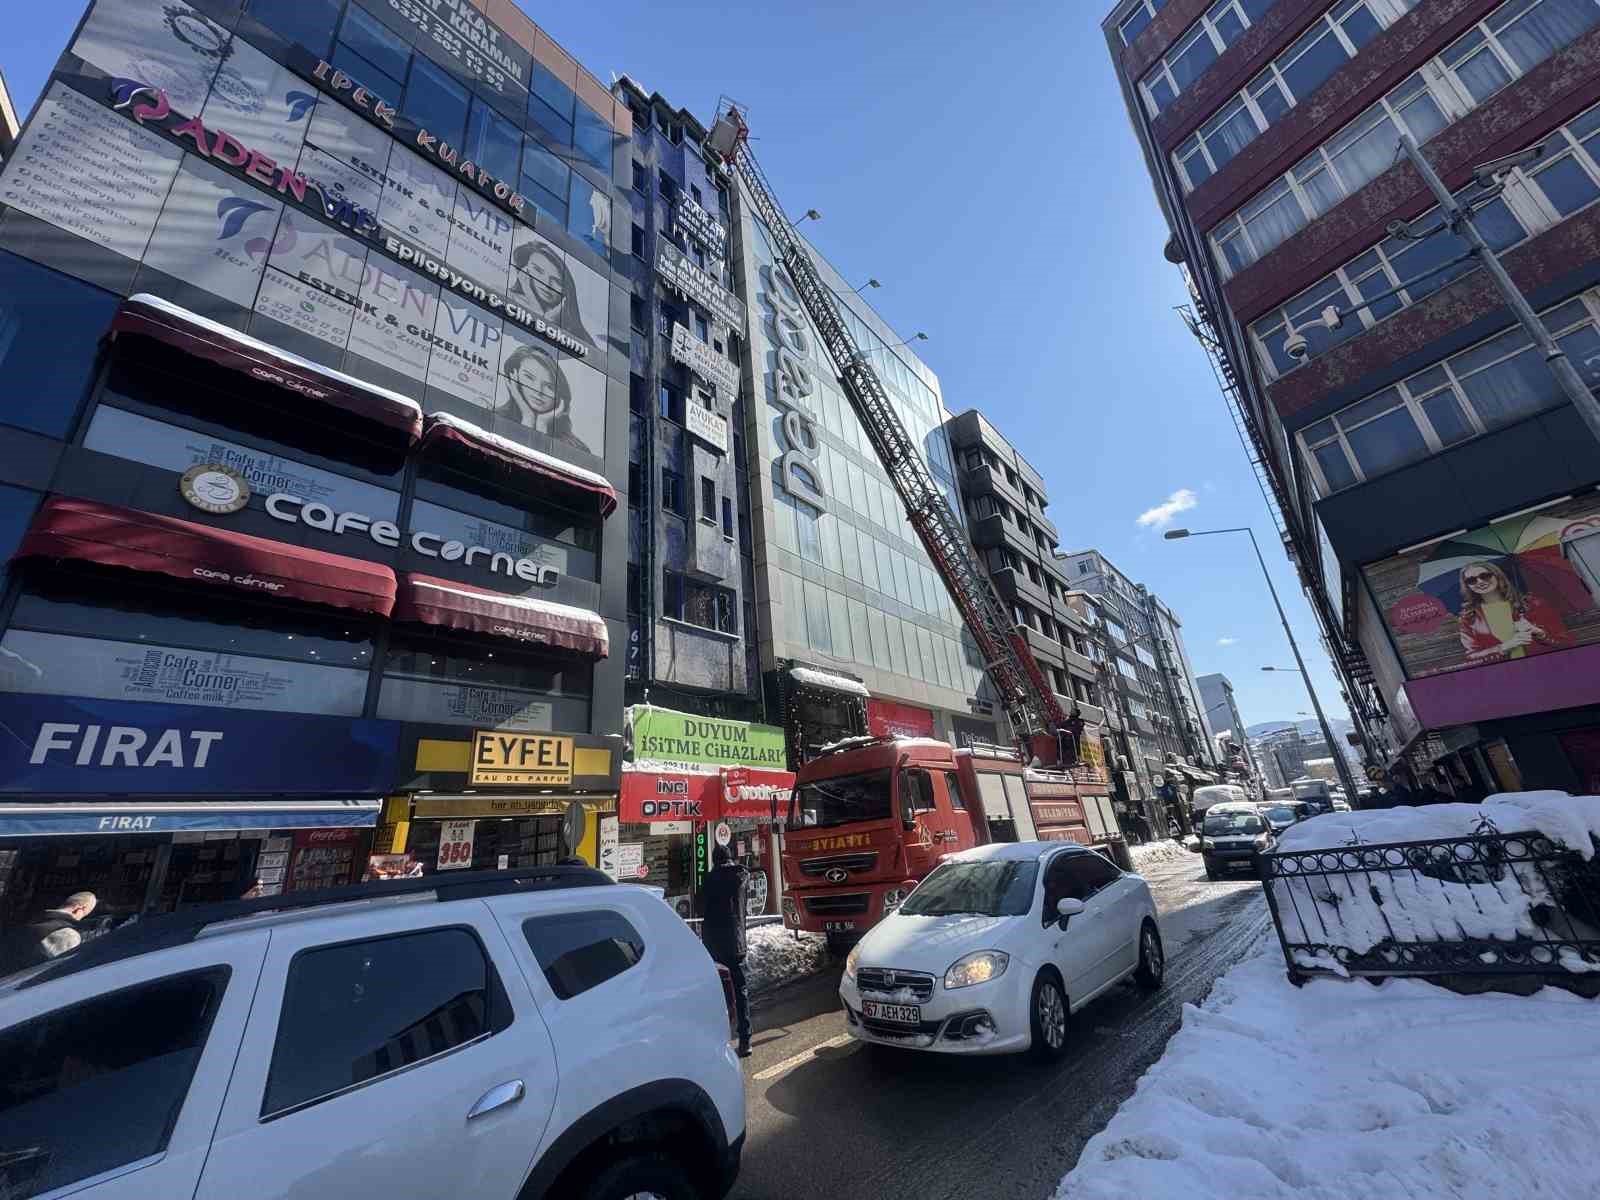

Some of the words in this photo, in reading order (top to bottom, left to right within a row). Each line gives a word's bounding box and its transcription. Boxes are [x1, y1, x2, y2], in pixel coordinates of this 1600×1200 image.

[449, 11, 522, 80] KARAMAN
[172, 114, 308, 202] ADEN
[386, 238, 489, 300] Epilasyon
[506, 302, 533, 324] Cilt
[680, 255, 727, 302] AVUKAT
[302, 239, 431, 319] ADEN
[441, 297, 500, 348] VIP
[385, 313, 399, 328] &
[406, 324, 489, 370] GÜZELLİK
[766, 264, 827, 514] DeFacto
[689, 405, 723, 432] AVUKAT
[243, 465, 290, 488] Corner
[164, 654, 198, 670] Cafe
[183, 668, 239, 691] Corner
[684, 719, 748, 743] DUYUM
[29, 722, 223, 768] FIRAT
[478, 735, 569, 767] EYFEL
[641, 735, 701, 757] İŞİTME
[656, 777, 688, 793] İNCİ
[641, 795, 703, 817] OPTİK
[98, 815, 156, 831] FIRAT
[867, 1004, 878, 1017] 67
[881, 1006, 898, 1019] AEH
